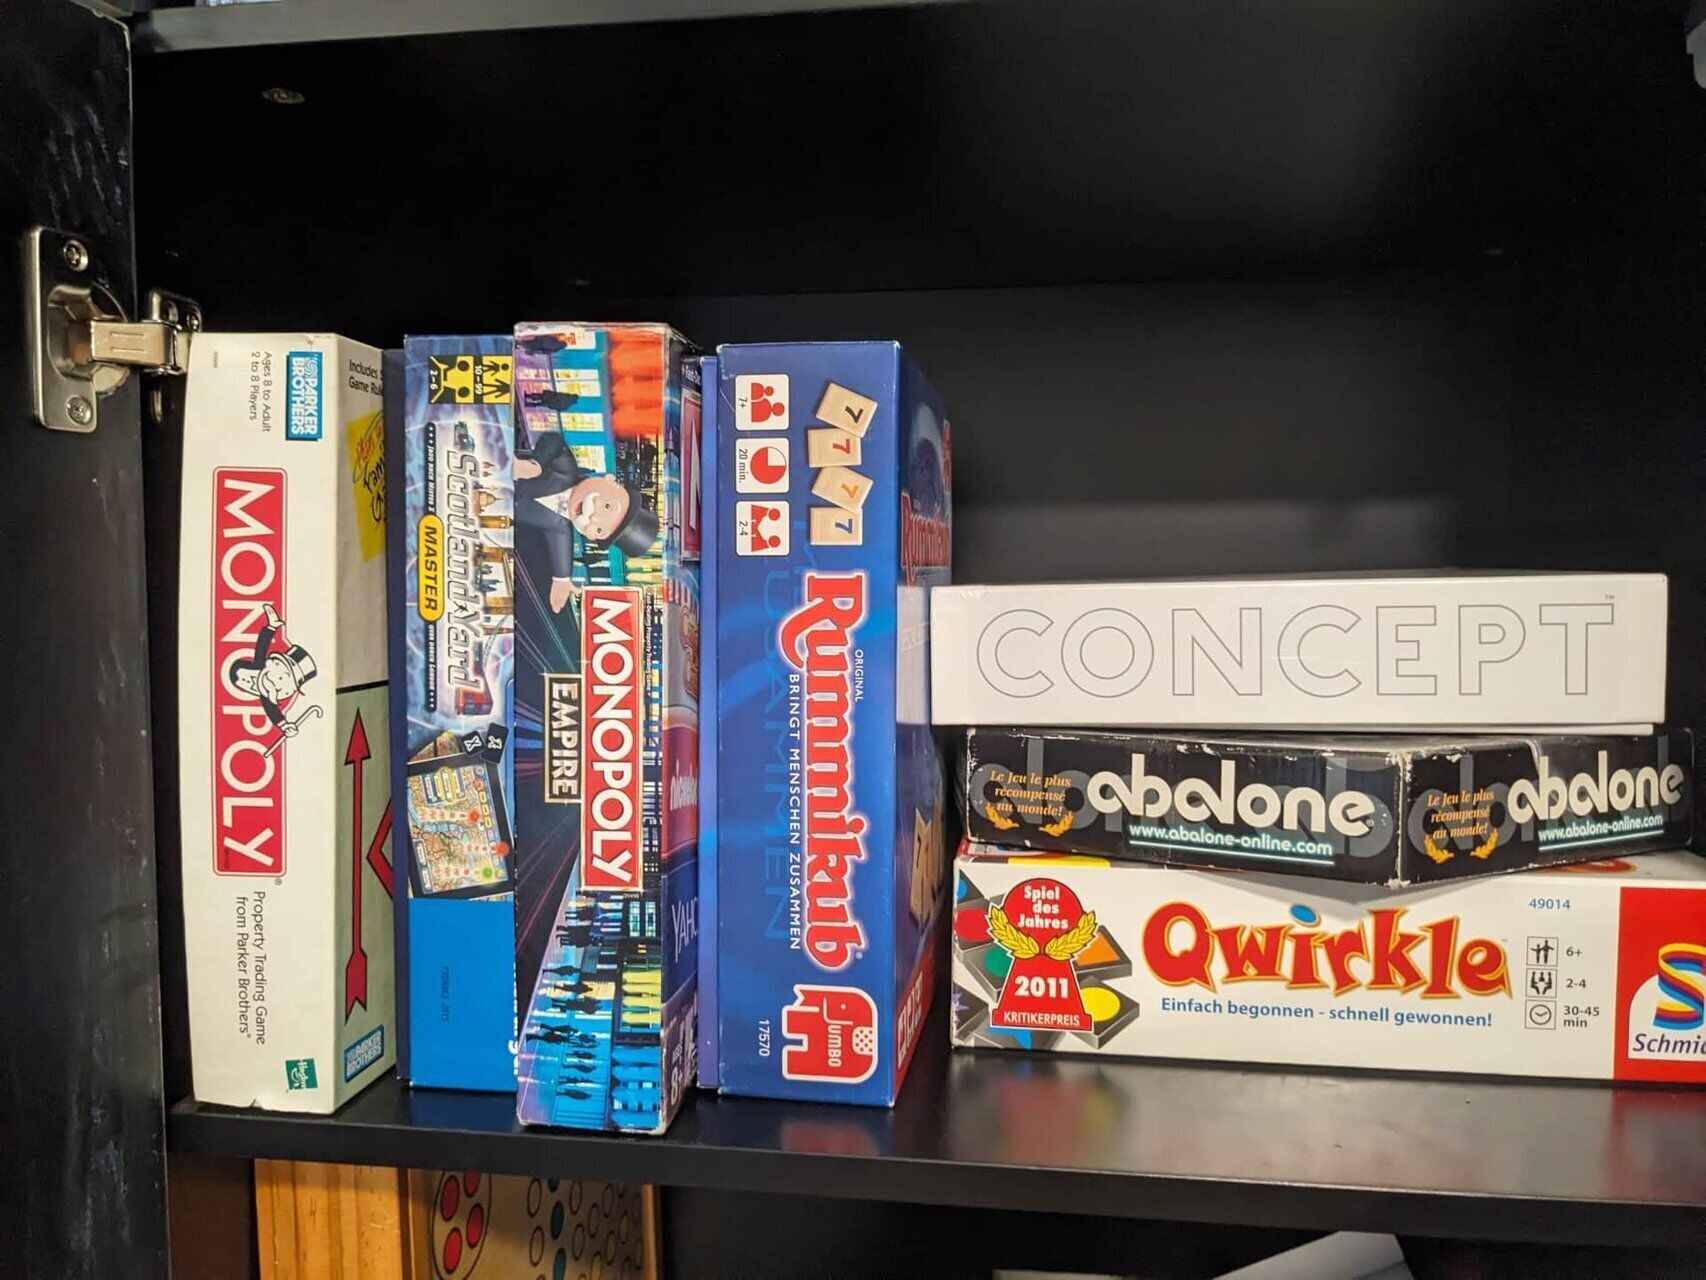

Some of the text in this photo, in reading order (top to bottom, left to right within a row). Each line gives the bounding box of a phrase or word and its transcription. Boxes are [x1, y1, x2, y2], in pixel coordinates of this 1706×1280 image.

[251, 360, 261, 372] to
[348, 358, 378, 379] Includes
[251, 376, 260, 384] 8
[348, 376, 369, 393] Game
[262, 351, 273, 433] Ages 8 to Adult
[291, 356, 305, 435] BROTHERS
[738, 397, 748, 408] 7+
[249, 386, 260, 421] Players
[304, 377, 319, 435] PARKER
[844, 405, 864, 424] 7
[832, 438, 851, 455] 7
[738, 448, 749, 484] 20 min.
[840, 483, 859, 499] 7
[738, 521, 748, 536] 2-4
[834, 518, 853, 534] 7
[424, 526, 438, 611] MASTER
[446, 450, 481, 690] Scotland Yard
[977, 603, 1614, 698] CONCEPT
[221, 479, 276, 867] MONOPOLY
[854, 649, 864, 703] ORIGINAL
[551, 682, 579, 796] EMPIRE
[591, 598, 635, 883] MONOPOLY
[780, 573, 867, 969] Rummikub
[990, 768, 1073, 788] Le Jeu le plus
[994, 785, 1067, 803] récompensé
[1087, 753, 1376, 837] abalone
[1427, 788, 1496, 807] Le Jeu le plus
[1507, 750, 1685, 825] abalone
[789, 673, 801, 950] BRINGT MENSCHEN ZUSAMMEN
[996, 801, 1063, 817] au monde!
[1430, 806, 1490, 824] récompensé
[1432, 822, 1489, 840] au monde!
[1537, 814, 1664, 842] www.abalone-online.com
[1128, 822, 1334, 857] www.abalone-online.com
[1023, 885, 1060, 904] Spiel
[1528, 898, 1571, 911] 49014
[1032, 902, 1060, 915] des
[1017, 914, 1069, 930] Jahres
[1141, 900, 1513, 1000] Qwirkle
[1565, 946, 1583, 958] 6+
[236, 896, 251, 1034] from Parker Brothers
[250, 890, 268, 1045] Property Trading Game
[1014, 975, 1069, 999] 2011
[1565, 977, 1587, 989] 2-4
[1003, 1010, 1080, 1027] KRITIKERPREIS
[1161, 997, 1223, 1014] Einfach
[1227, 1000, 1314, 1018] begonnen
[1328, 1005, 1390, 1022] schnell
[1394, 1012, 1493, 1027] gewonnen!
[1563, 1005, 1601, 1017] 30-45
[1563, 1017, 1588, 1028] min
[758, 1018, 770, 1057] 17570
[823, 1003, 853, 1068] JUMBO
